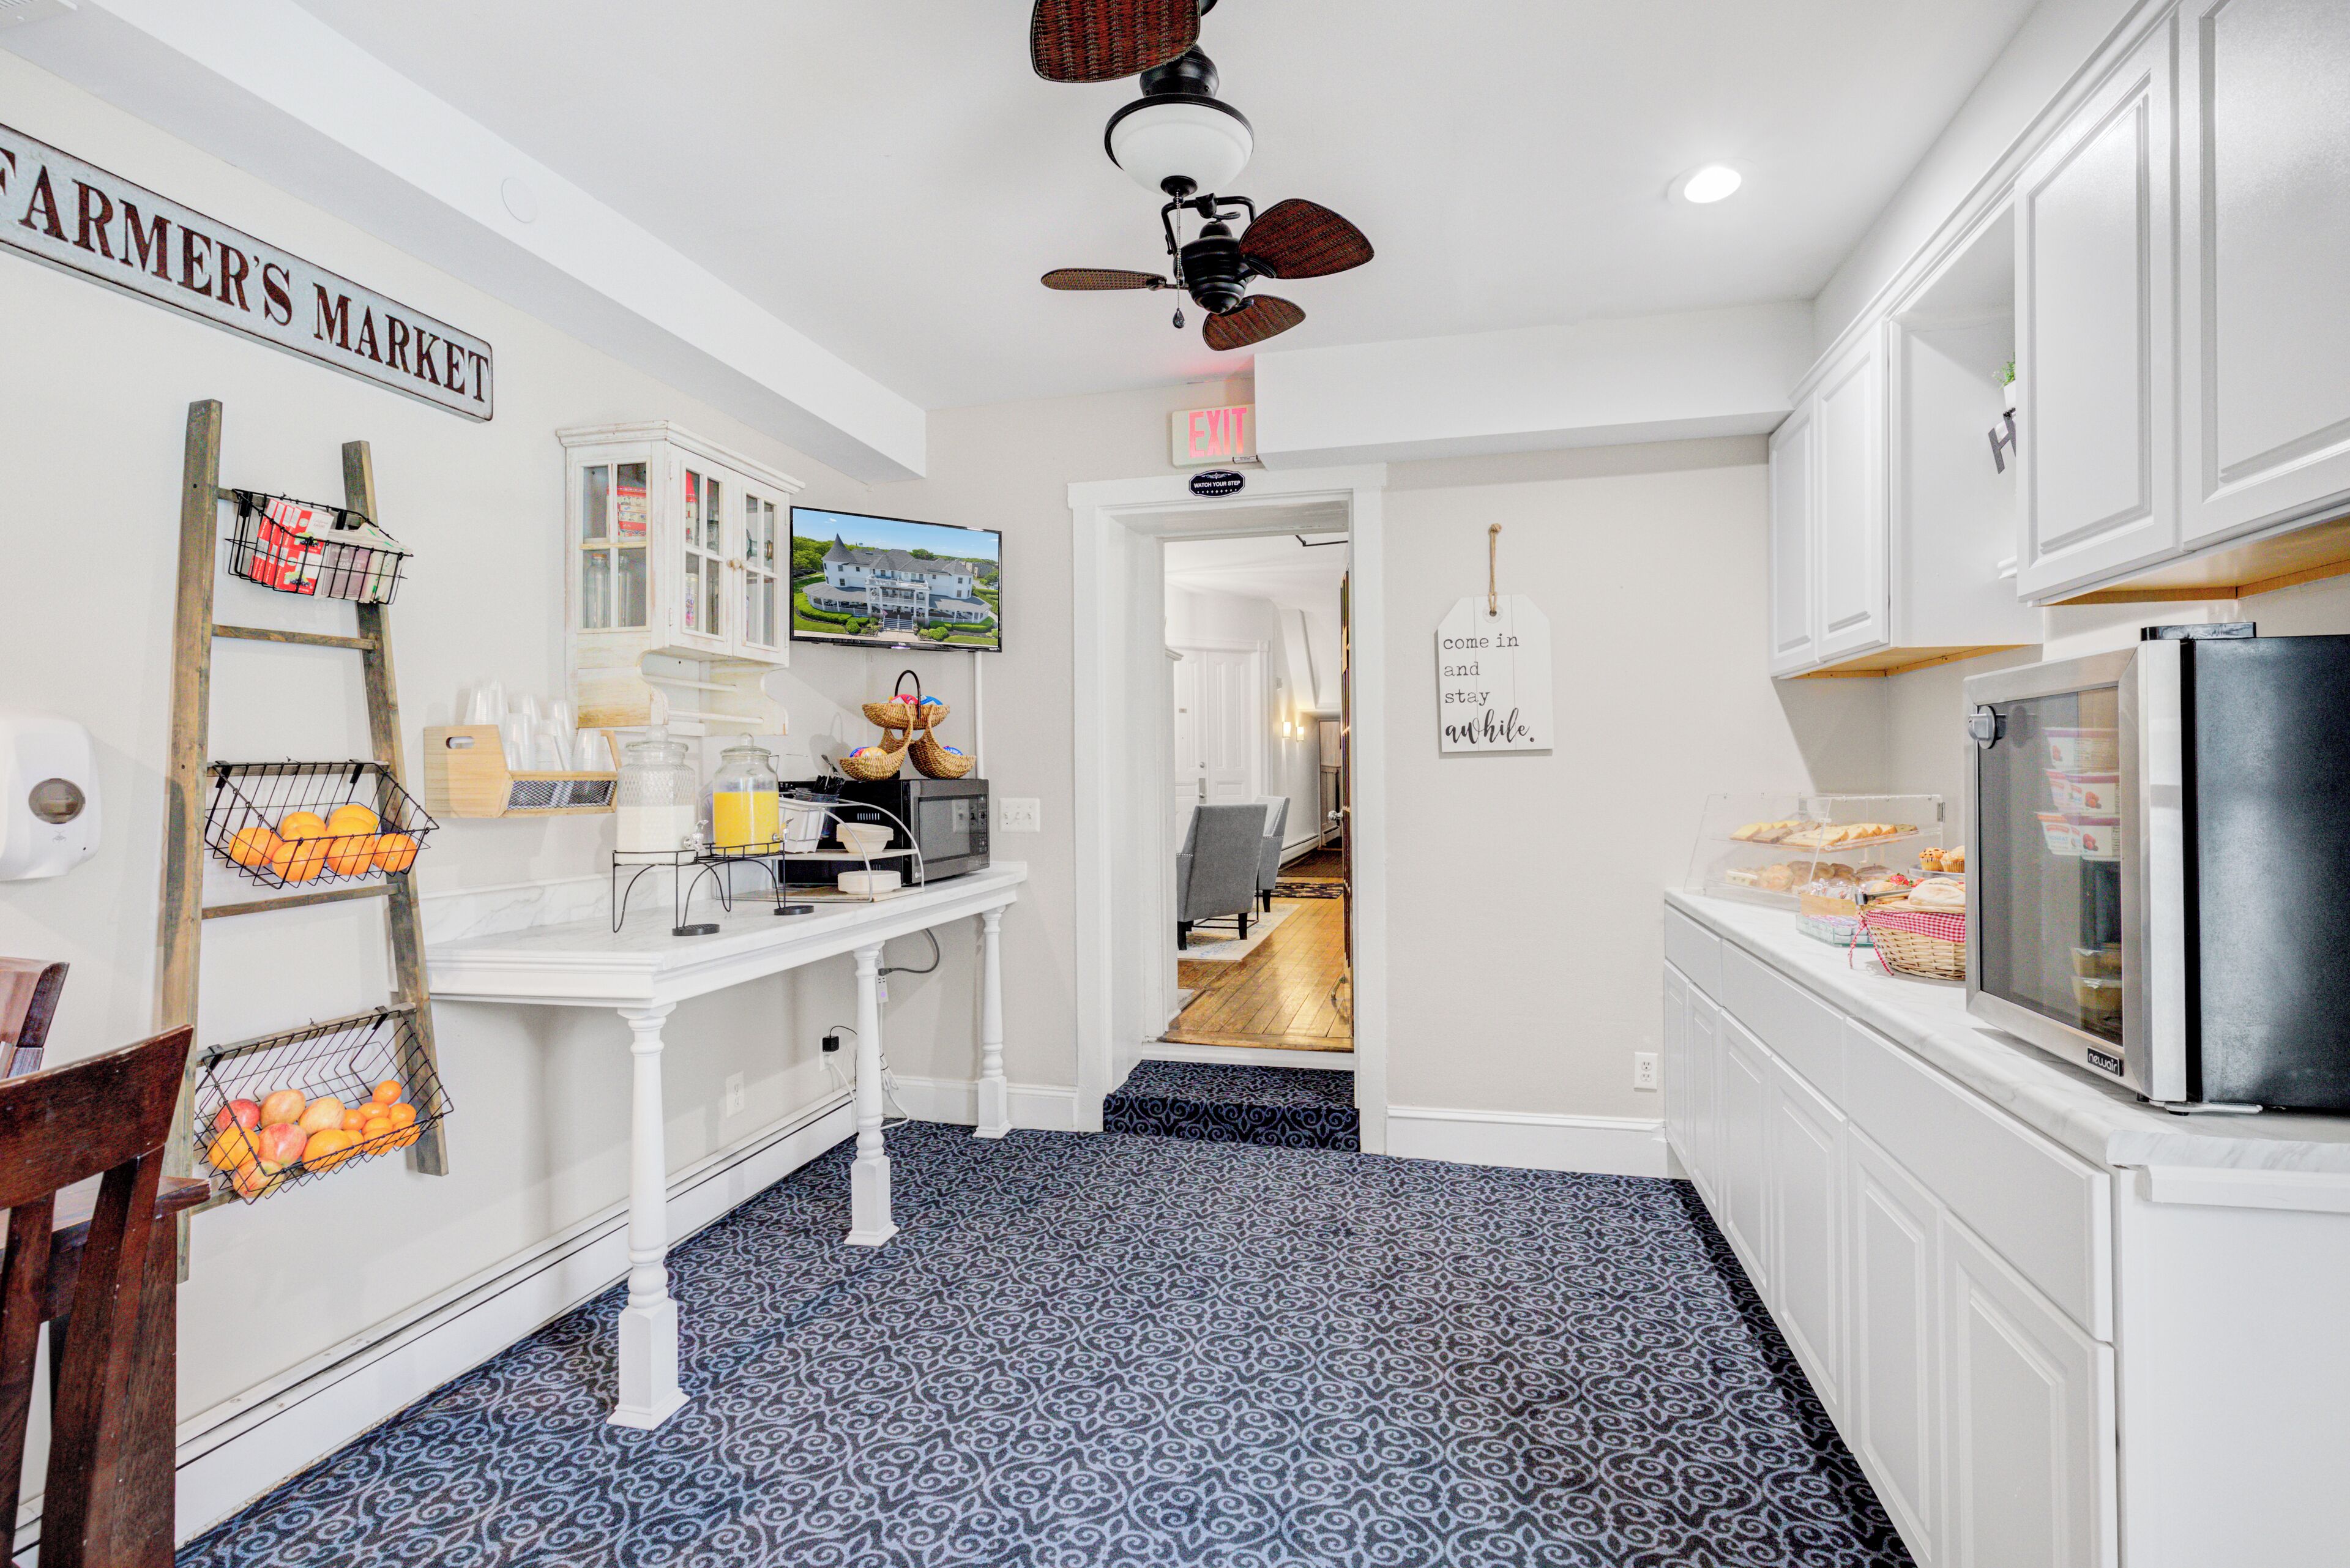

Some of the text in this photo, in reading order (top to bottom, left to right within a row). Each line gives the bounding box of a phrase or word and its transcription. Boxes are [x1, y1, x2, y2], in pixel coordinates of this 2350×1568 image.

[312, 282, 490, 403] MARKET
[1188, 407, 1247, 458] EXIT
[1442, 633, 1520, 650] come in
[1444, 661, 1481, 677] and
[1444, 689, 1491, 706] stay
[1445, 707, 1535, 745] awhile.
[2088, 1053, 2117, 1072] newair
